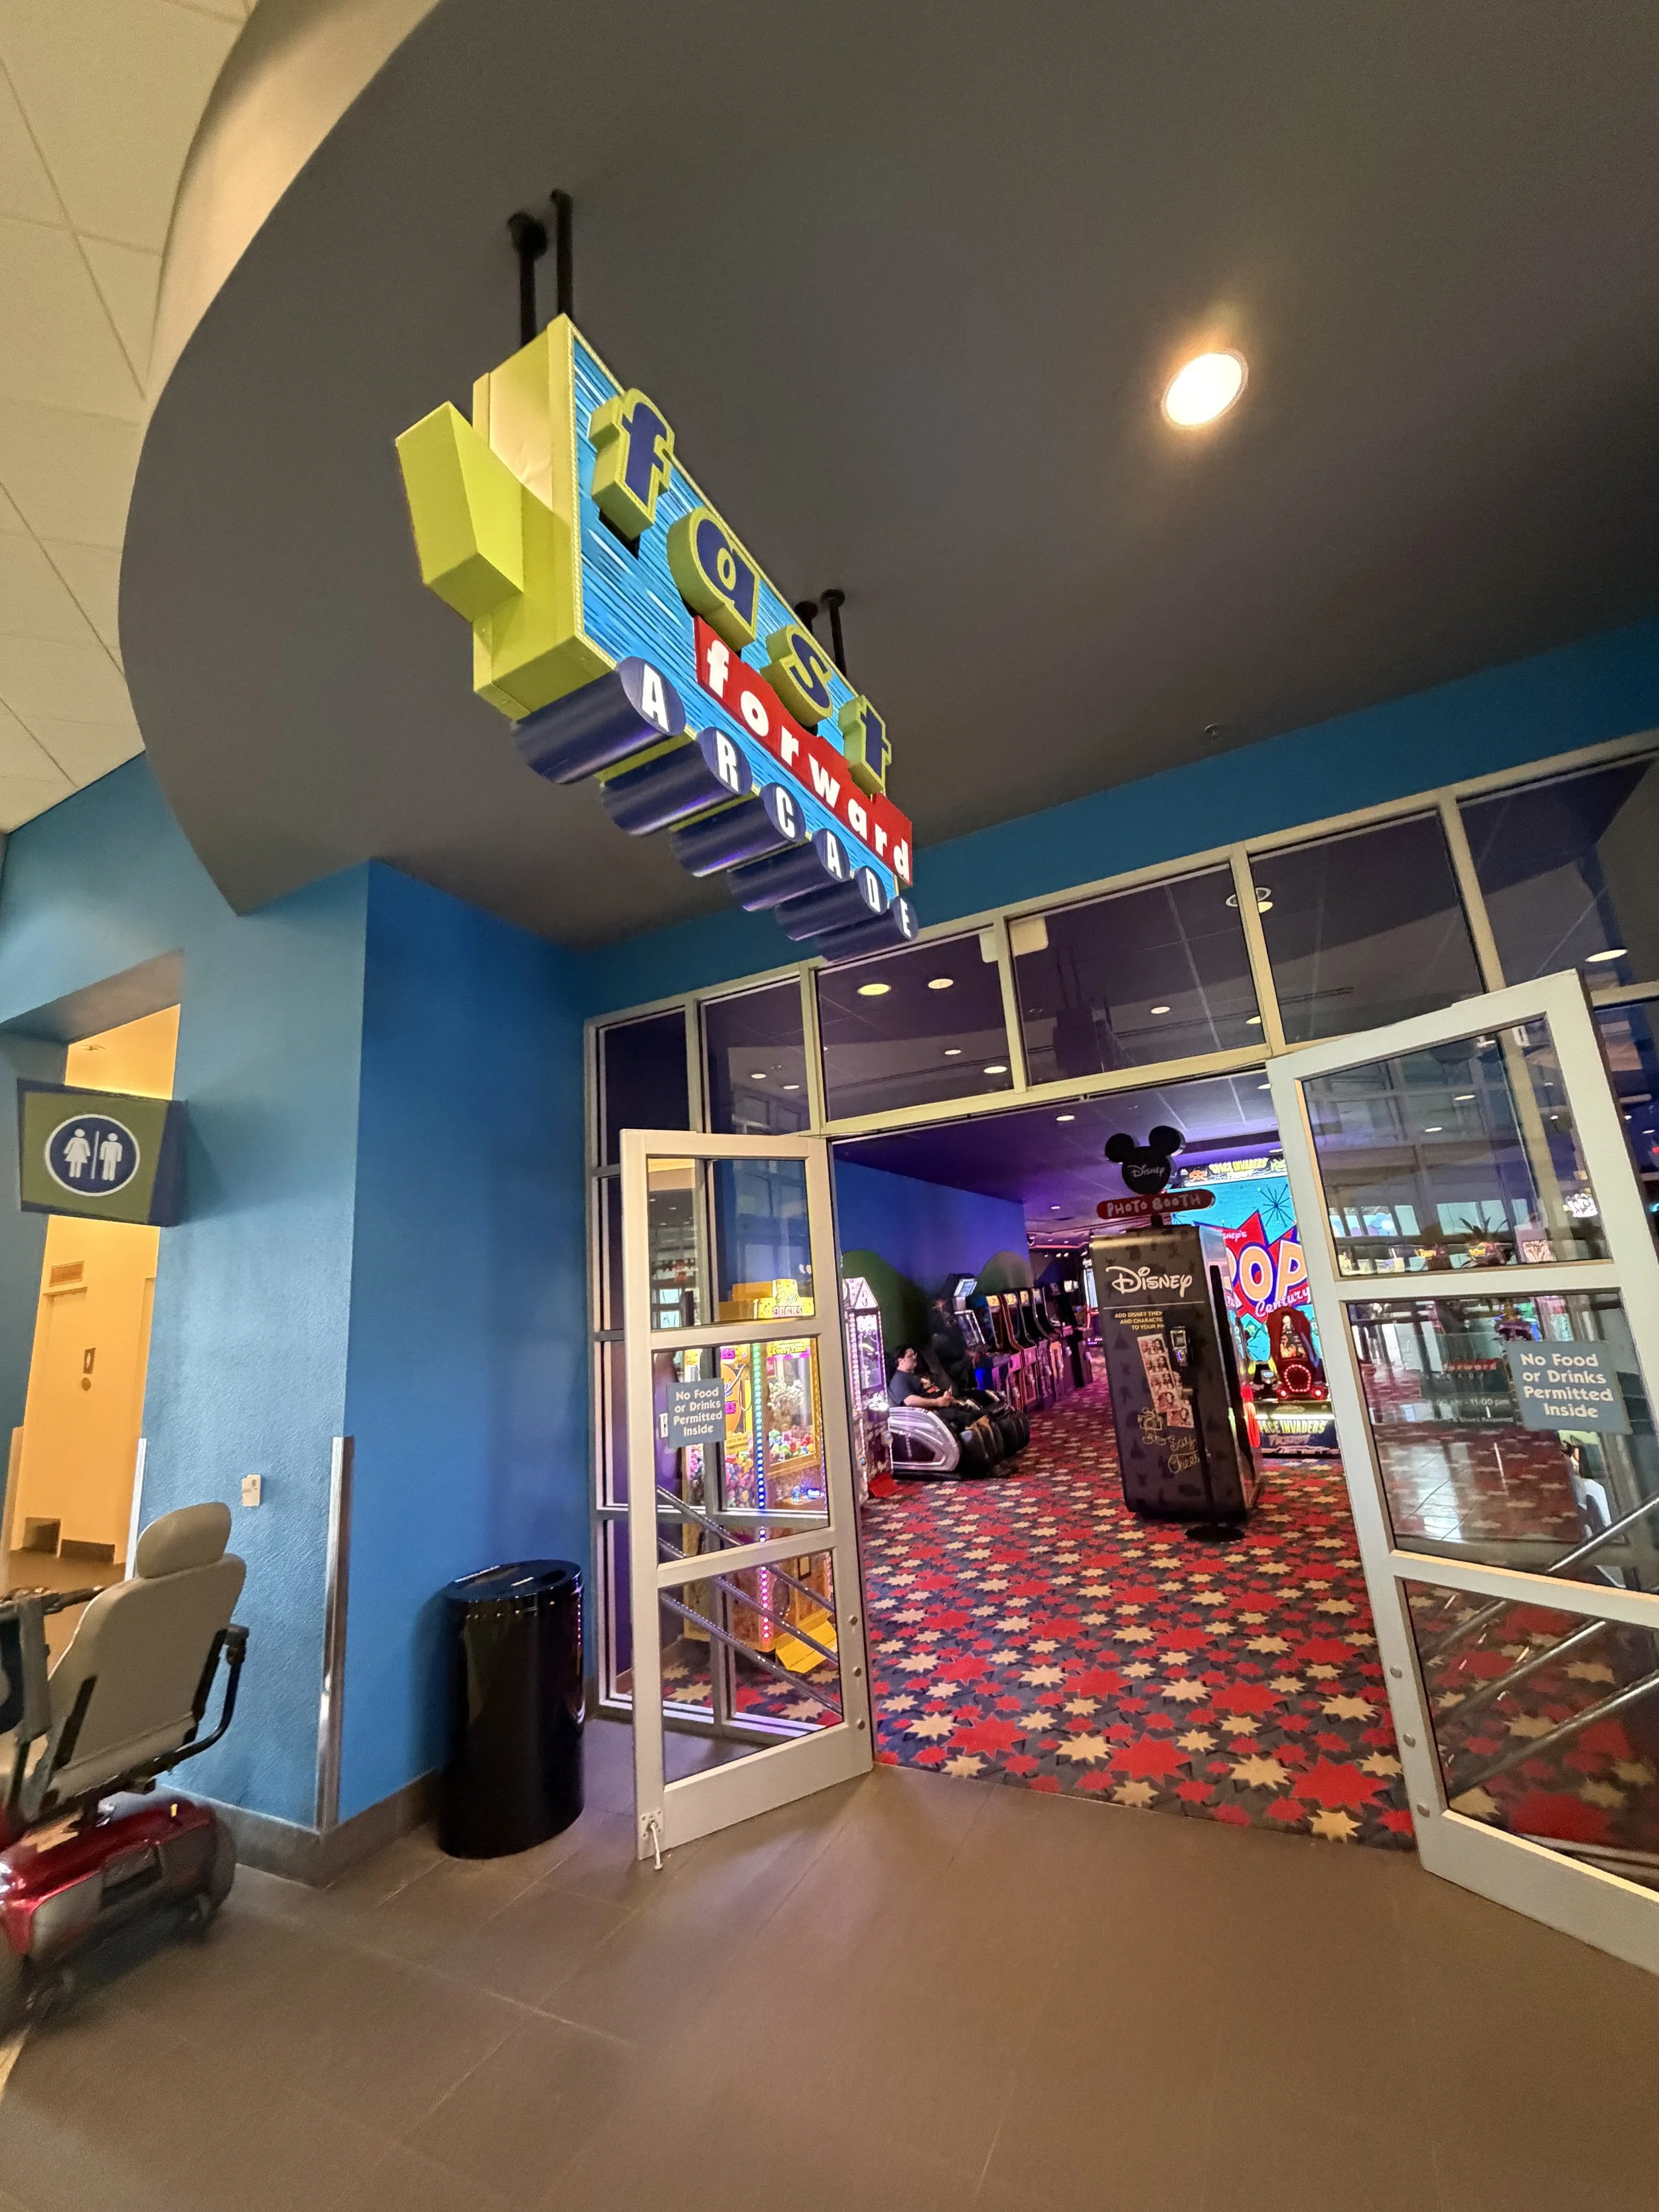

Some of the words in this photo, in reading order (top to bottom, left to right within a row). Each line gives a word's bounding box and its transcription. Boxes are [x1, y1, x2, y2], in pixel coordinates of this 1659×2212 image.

[614, 389, 891, 792] fast
[706, 640, 910, 885] forward
[641, 670, 912, 938] ARCADE
[1107, 1200, 1147, 1217] PHOTO
[1152, 1194, 1201, 1210] BOOTH
[1255, 1286, 1311, 1317] Century
[1520, 1353, 1547, 1366] No
[1551, 1353, 1599, 1367] Food
[1522, 1371, 1541, 1383] or
[1547, 1369, 1607, 1384] Drinks
[676, 1390, 691, 1401] No
[694, 1387, 719, 1399] Food
[1523, 1385, 1615, 1402] Permitted
[674, 1404, 686, 1413] or
[689, 1400, 721, 1412] Drinks
[1543, 1402, 1599, 1418] Inside
[673, 1410, 723, 1426] Permitted
[683, 1424, 714, 1437] Inside
[1258, 1420, 1280, 1434] PACE
[1279, 1420, 1327, 1434] INVADERS
